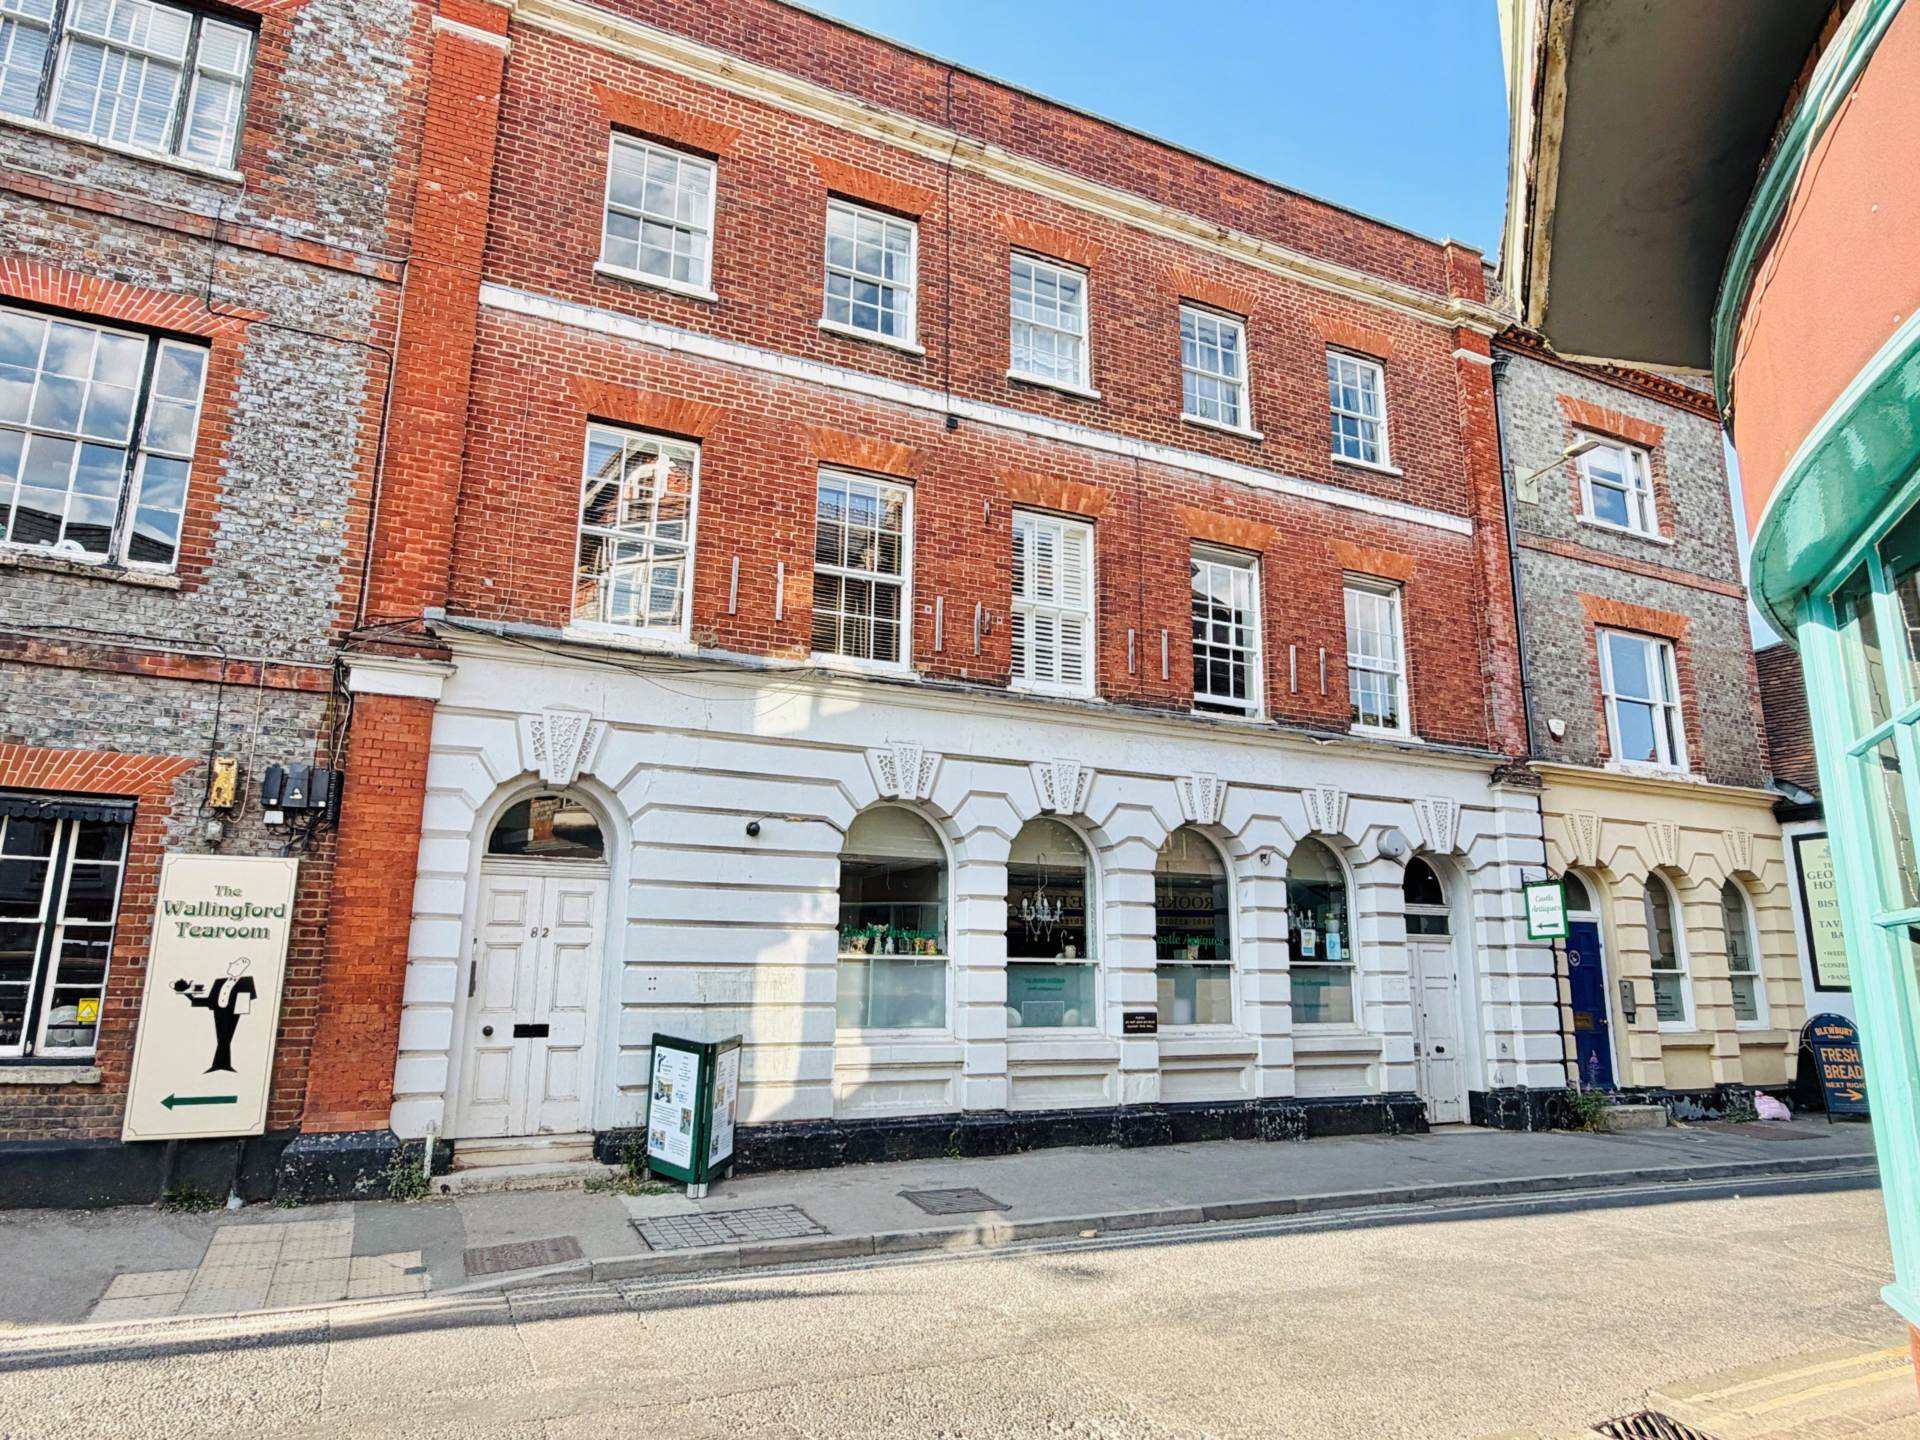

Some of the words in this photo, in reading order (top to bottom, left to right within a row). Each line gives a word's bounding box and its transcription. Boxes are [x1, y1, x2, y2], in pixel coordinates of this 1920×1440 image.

[1806, 870, 1834, 881] GEO
[214, 884, 242, 897] The
[1817, 899, 1839, 908] BIST
[163, 900, 288, 922] Wallingford
[1818, 919, 1843, 929] TAV
[174, 921, 271, 941] Tearoom
[1820, 1048, 1860, 1062] FRESH
[1823, 1064, 1865, 1079] BREAD
